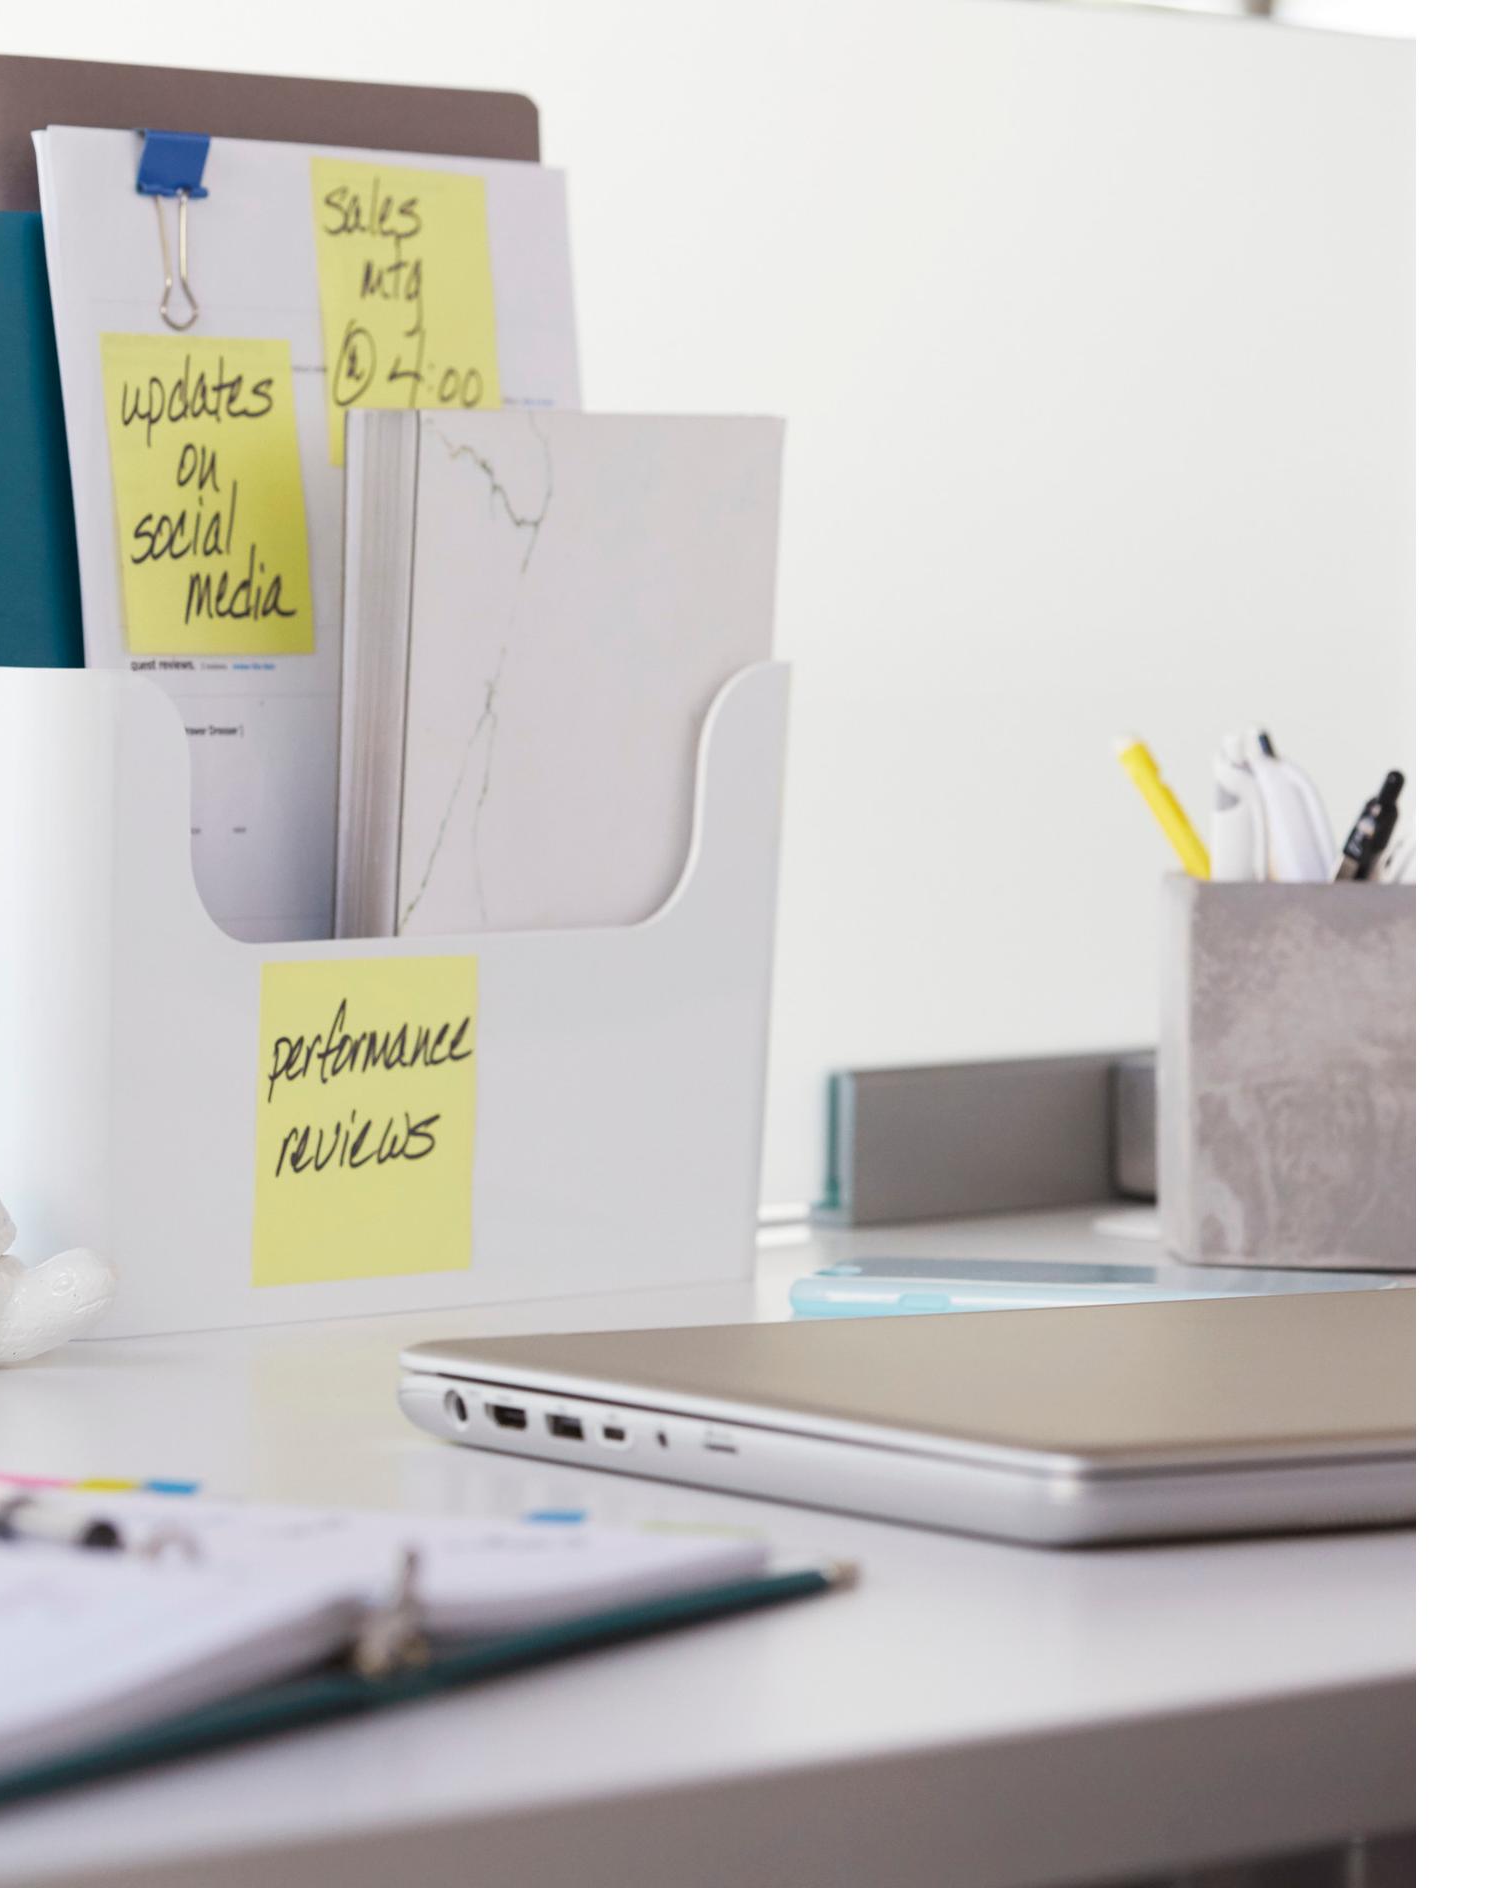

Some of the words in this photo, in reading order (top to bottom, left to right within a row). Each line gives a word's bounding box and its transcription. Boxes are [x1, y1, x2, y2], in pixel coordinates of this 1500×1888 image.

[323, 177, 422, 238] sales
[360, 243, 425, 336] mtg
[120, 354, 274, 447] updates
[387, 328, 482, 408] 4:00
[177, 443, 220, 492] on
[130, 481, 238, 565] social
[184, 543, 297, 625] media
[268, 998, 472, 1103] performance
[276, 1109, 441, 1177] reviews
